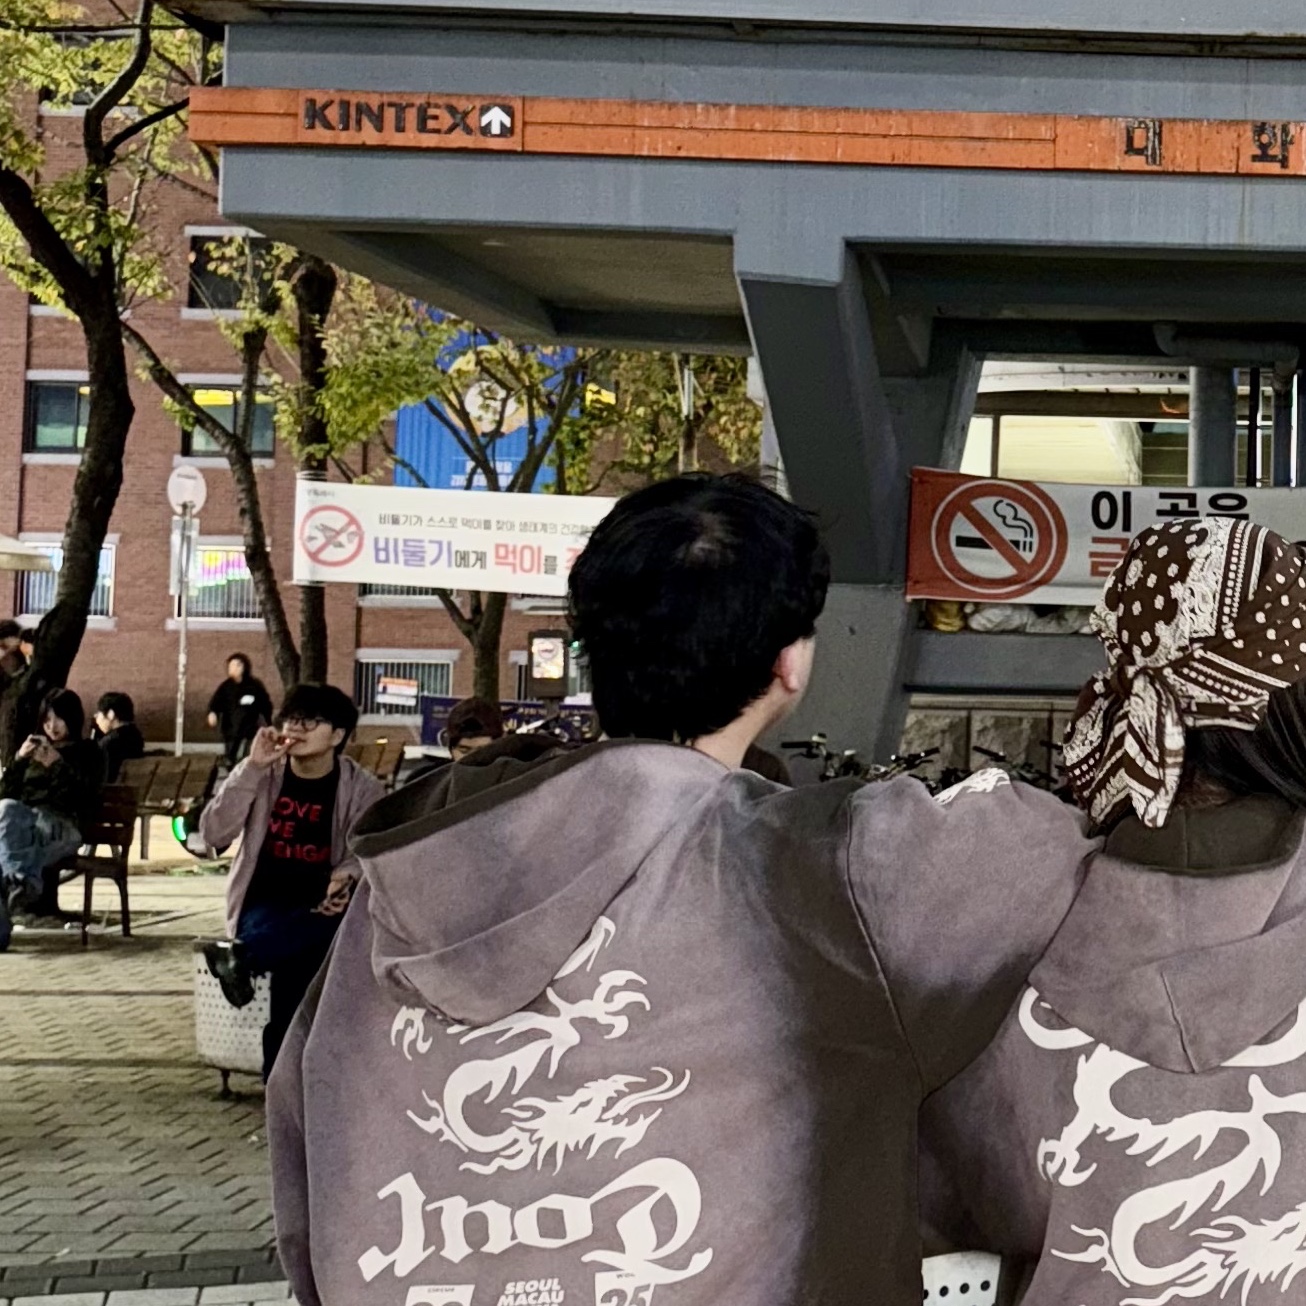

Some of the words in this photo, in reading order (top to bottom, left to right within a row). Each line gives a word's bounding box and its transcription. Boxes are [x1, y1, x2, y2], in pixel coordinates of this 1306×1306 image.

[304, 98, 475, 135] KINTEX
[379, 513, 423, 526] 비둘기가
[426, 516, 458, 529] 스스로
[461, 517, 492, 530] 먹이를
[1092, 490, 1131, 532] 이
[374, 536, 487, 569] 비둘기에게
[494, 543, 557, 575] 먹이를
[274, 796, 321, 822] OVE
[504, 1277, 561, 1295] SEOUL
